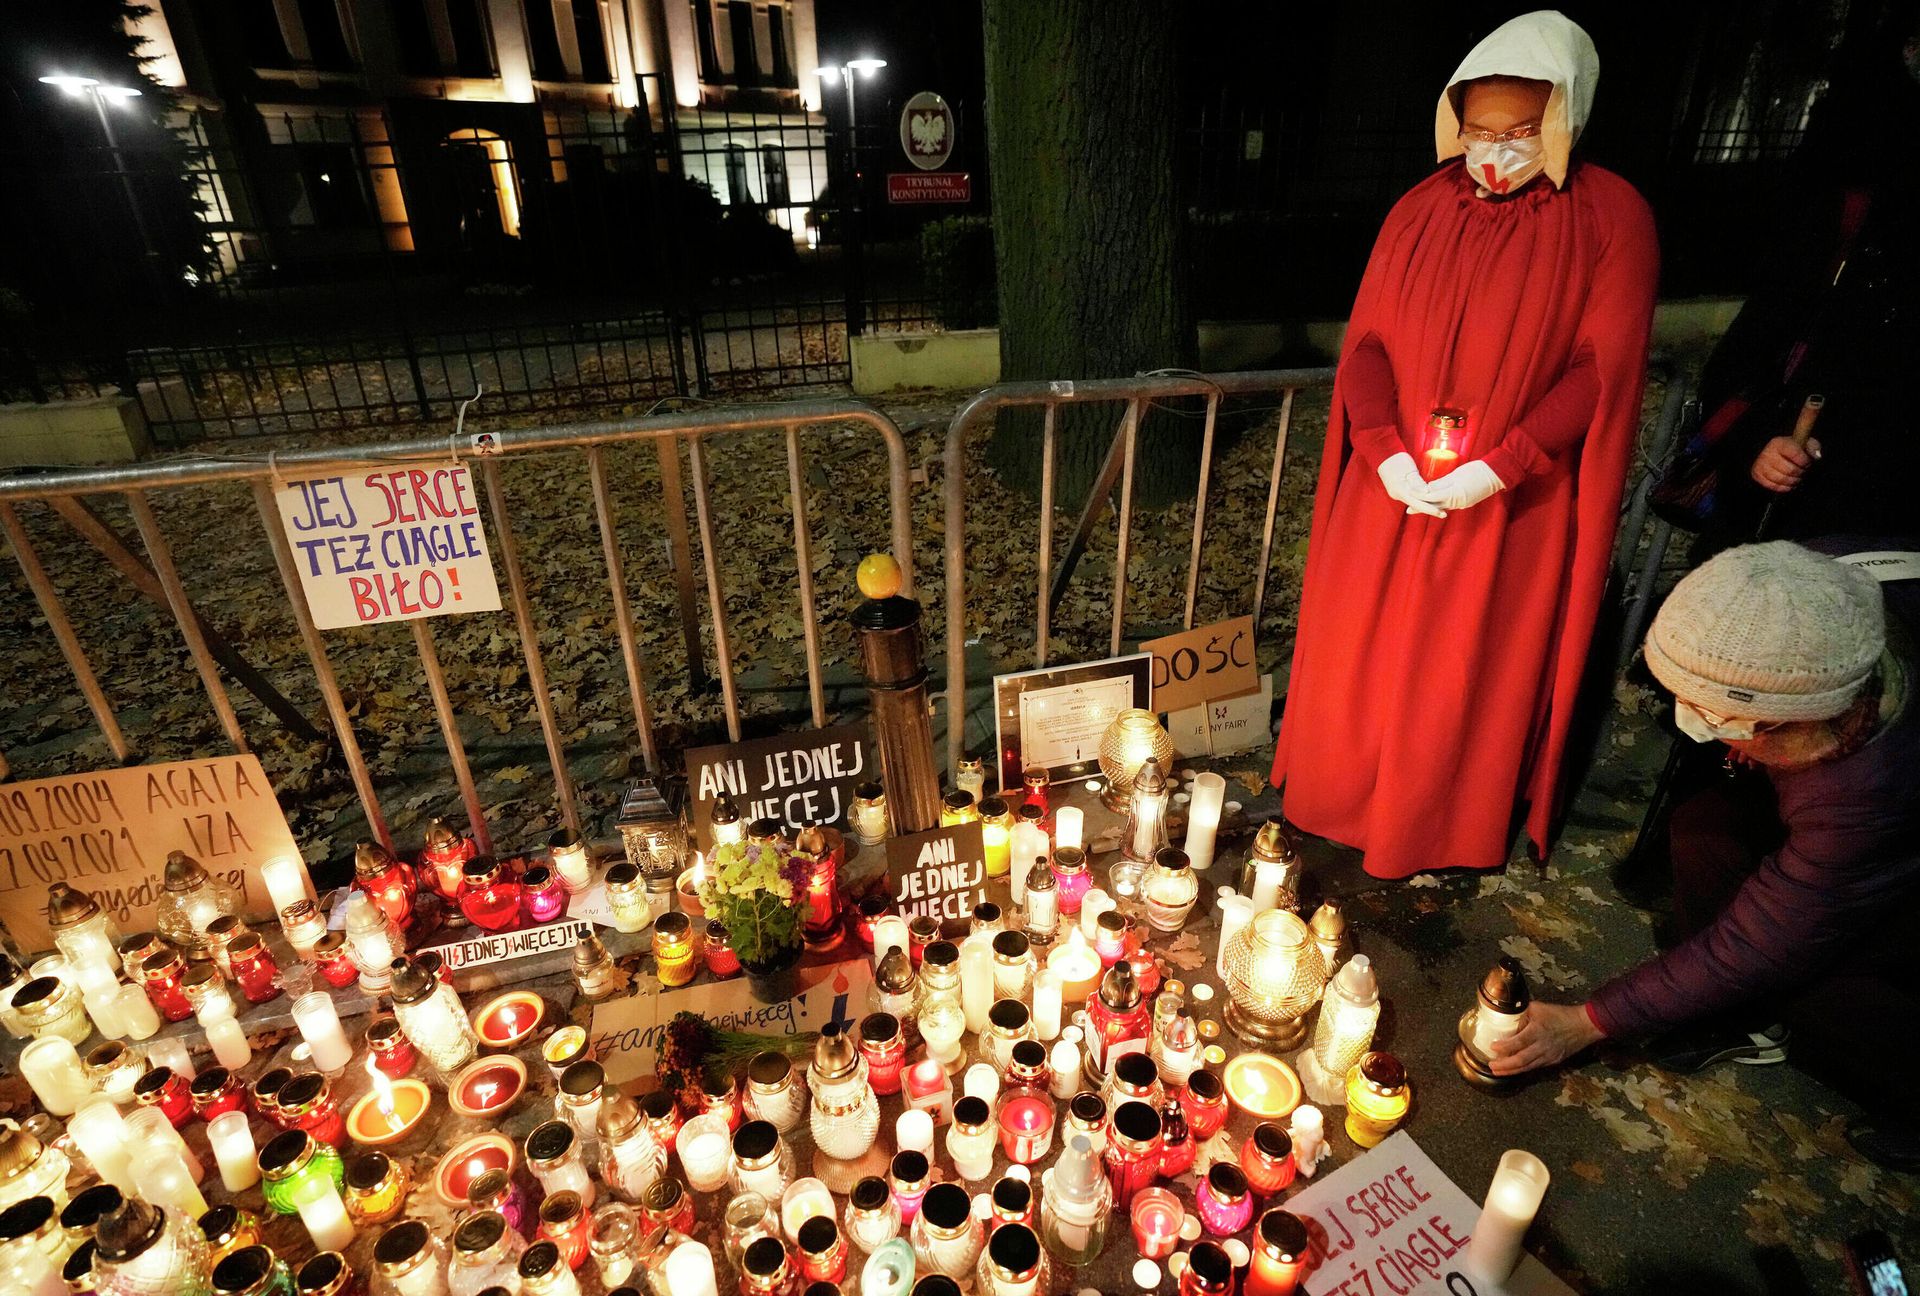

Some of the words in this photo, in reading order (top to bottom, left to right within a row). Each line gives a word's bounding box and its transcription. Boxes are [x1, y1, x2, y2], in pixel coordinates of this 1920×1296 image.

[892, 188, 967, 200] KONSTYTUCYJNY
[287, 477, 358, 531] JEJ
[365, 469, 477, 528] SERCE
[296, 534, 375, 577] TEŻ
[381, 522, 482, 568] CIĄGLE
[349, 567, 462, 621] BIŁO!
[1195, 723, 1222, 735] JENY
[1224, 719, 1248, 730] FAIRY
[147, 761, 260, 814] AGATA
[699, 760, 747, 800] ANI
[761, 741, 863, 791] JEDNEJ
[183, 811, 254, 858] IZA
[917, 837, 956, 868] ANI
[896, 860, 983, 902] JEDNEJ
[456, 938, 509, 967] JEDNEJ
[1346, 1166, 1432, 1238] SERCE
[1376, 1215, 1472, 1296] CIĄGLE
